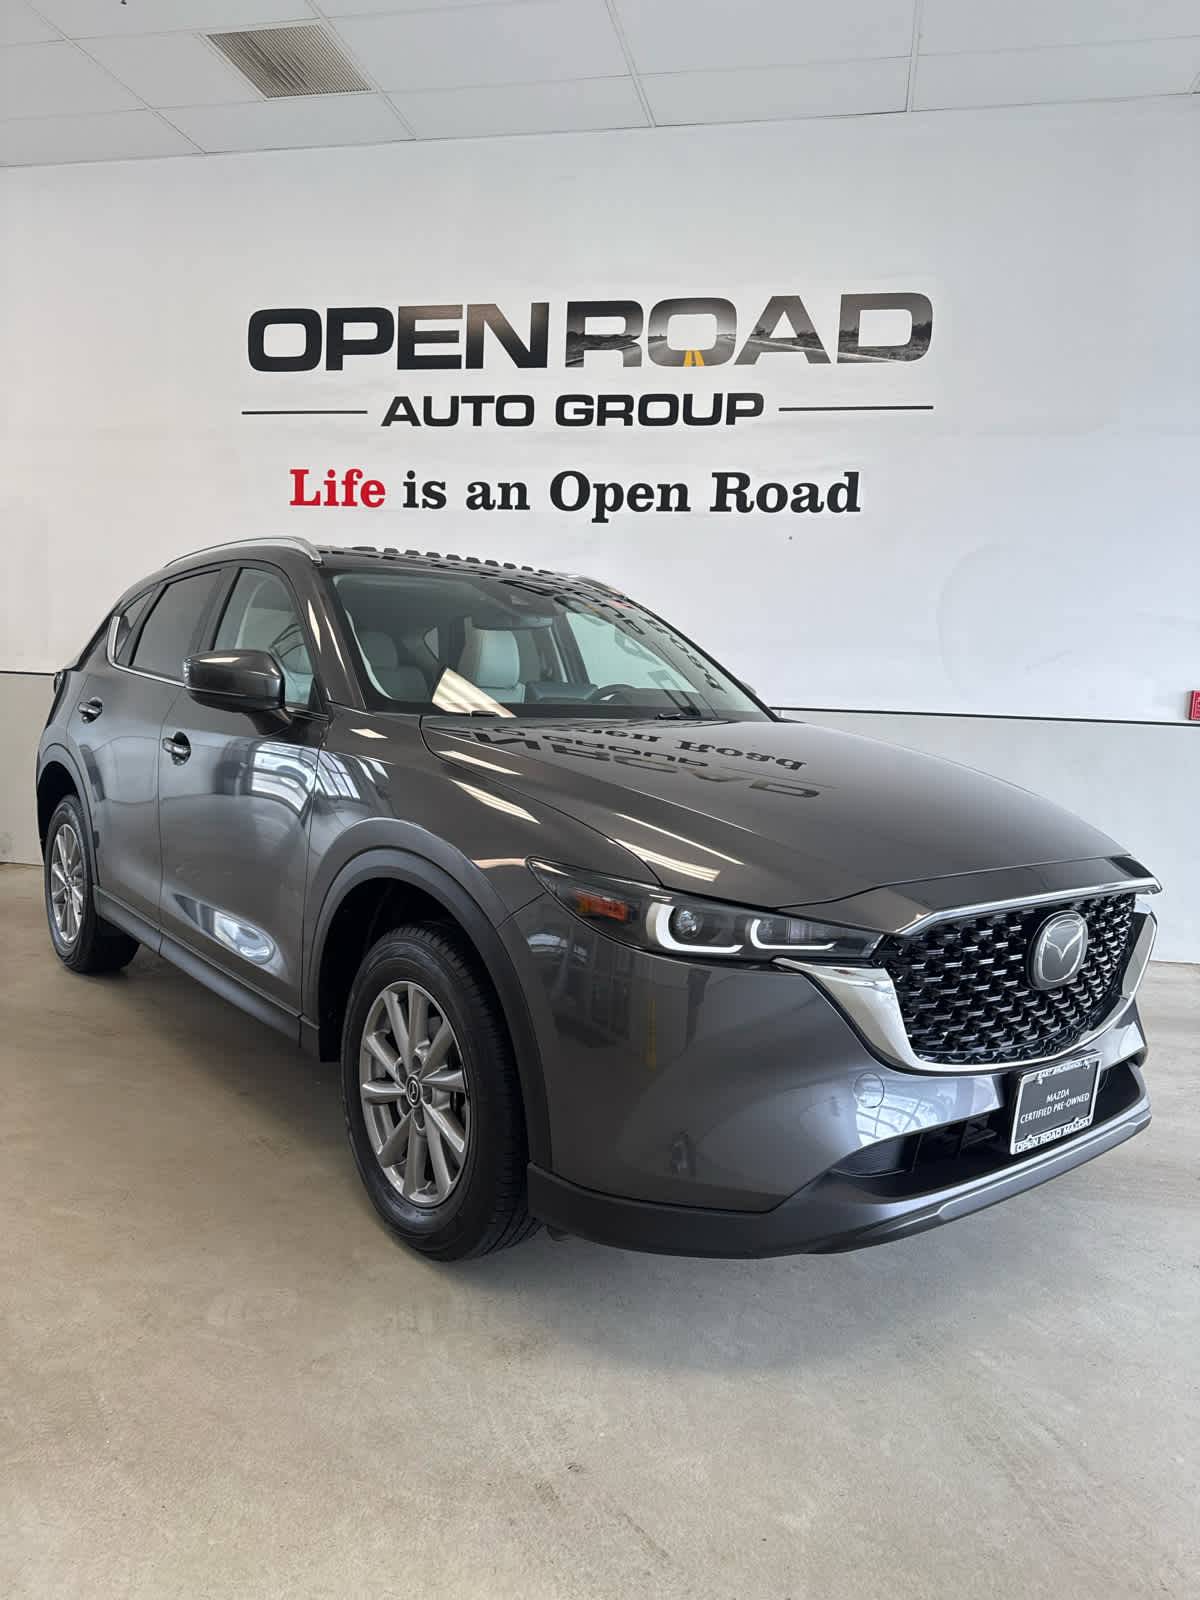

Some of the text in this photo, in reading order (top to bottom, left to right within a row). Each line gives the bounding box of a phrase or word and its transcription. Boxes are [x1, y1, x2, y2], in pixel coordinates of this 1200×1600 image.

[247, 292, 934, 373] OPEN ROAD
[381, 392, 765, 427] AUTO GROUP
[289, 468, 861, 524] Life is an Open Road
[1020, 1092, 1090, 1124] CERTIFIED PRE-OWNED
[1046, 1088, 1070, 1103] MAZDA
